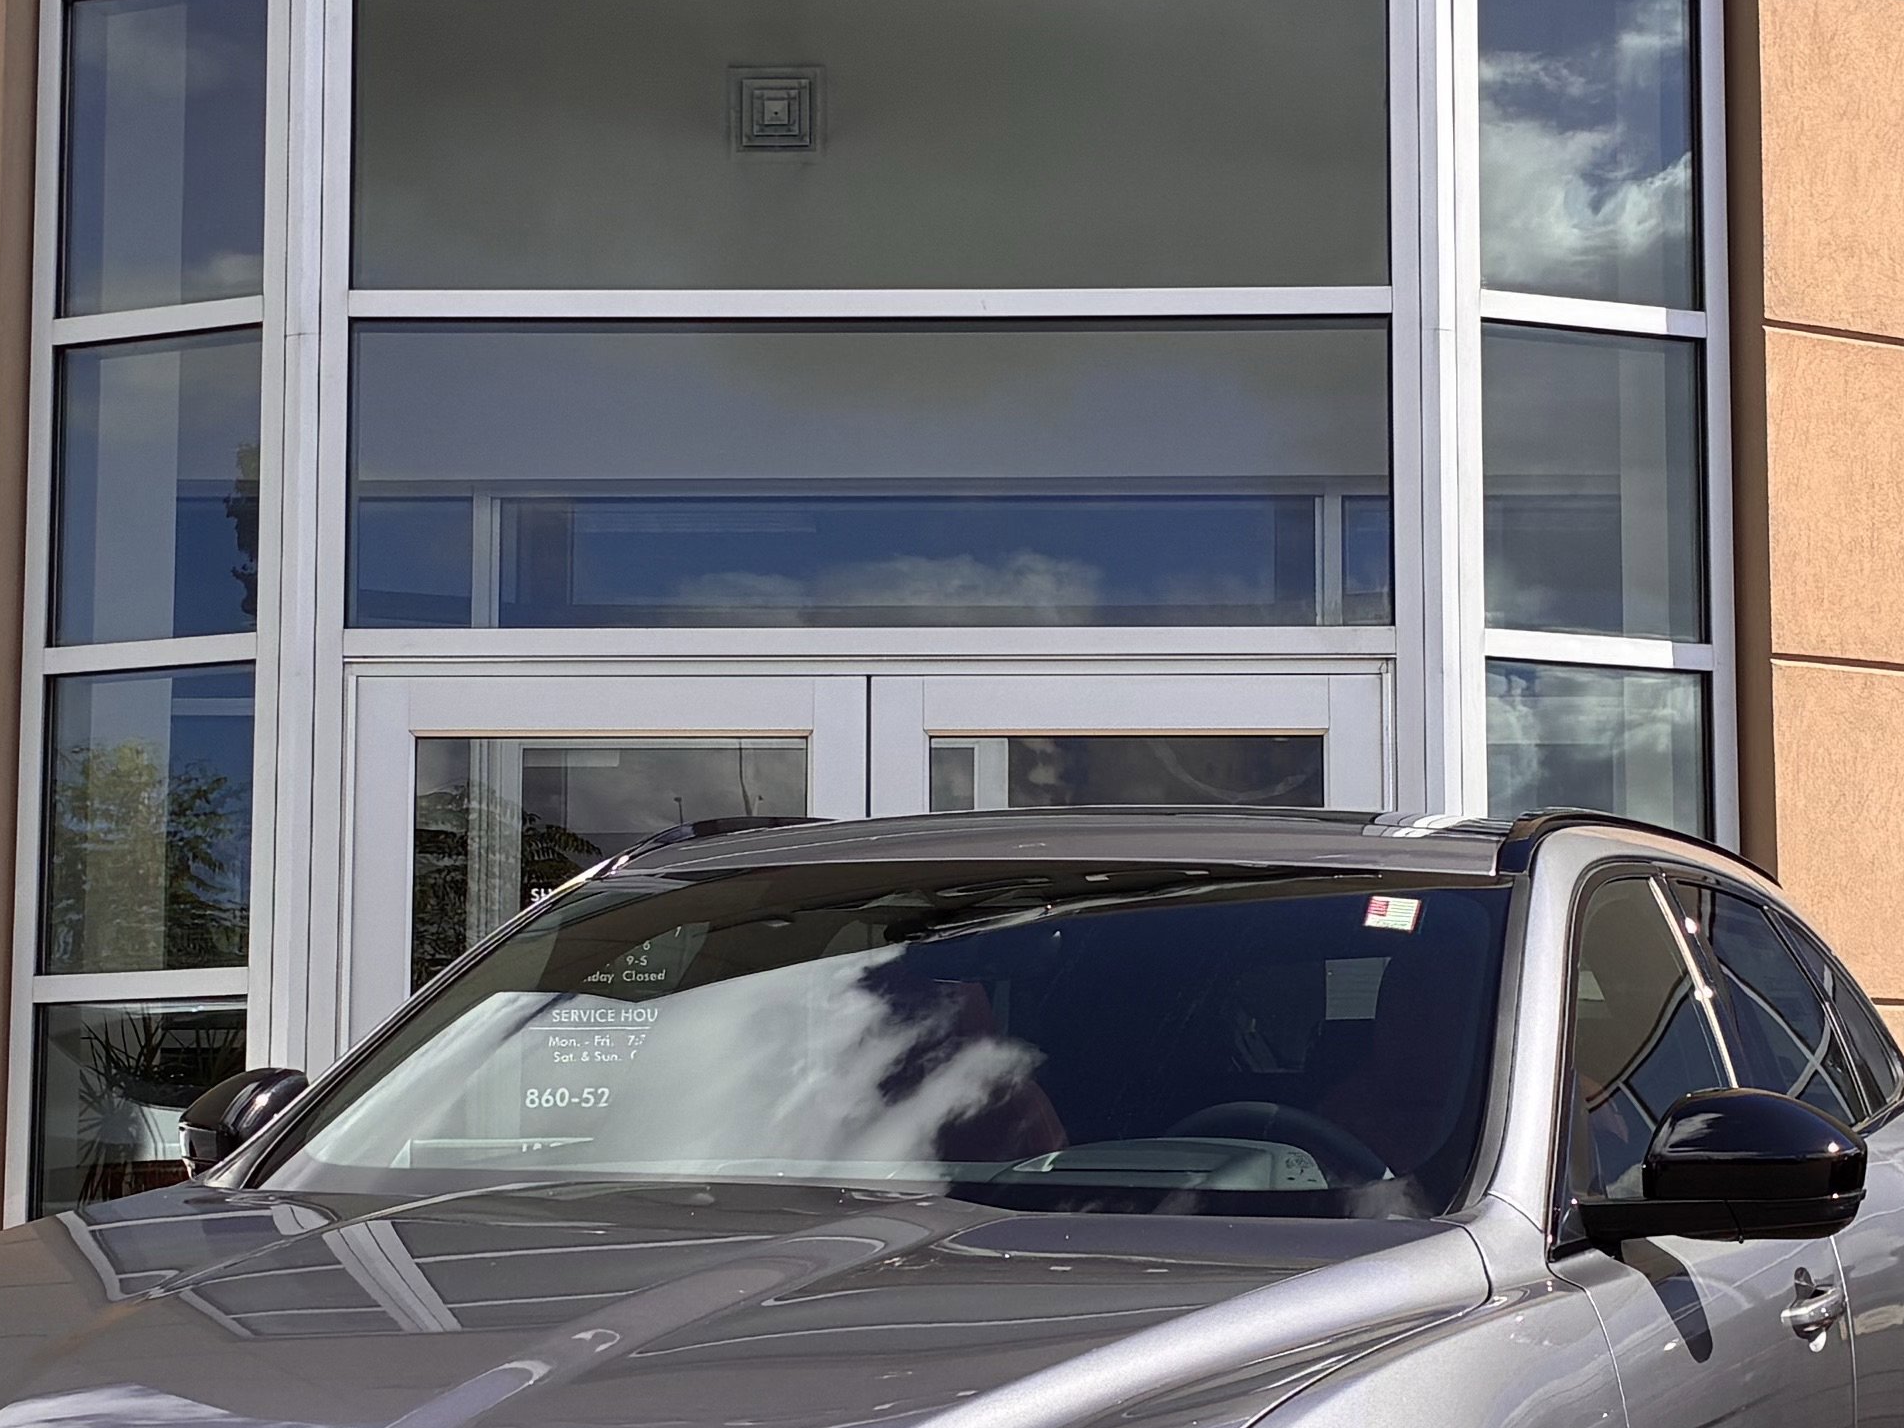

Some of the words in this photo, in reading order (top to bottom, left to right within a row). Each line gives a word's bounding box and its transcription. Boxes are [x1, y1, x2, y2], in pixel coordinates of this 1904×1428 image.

[622, 969, 666, 982] Closed
[552, 1009, 615, 1022] SERVICE
[548, 1036, 580, 1047] Mon.
